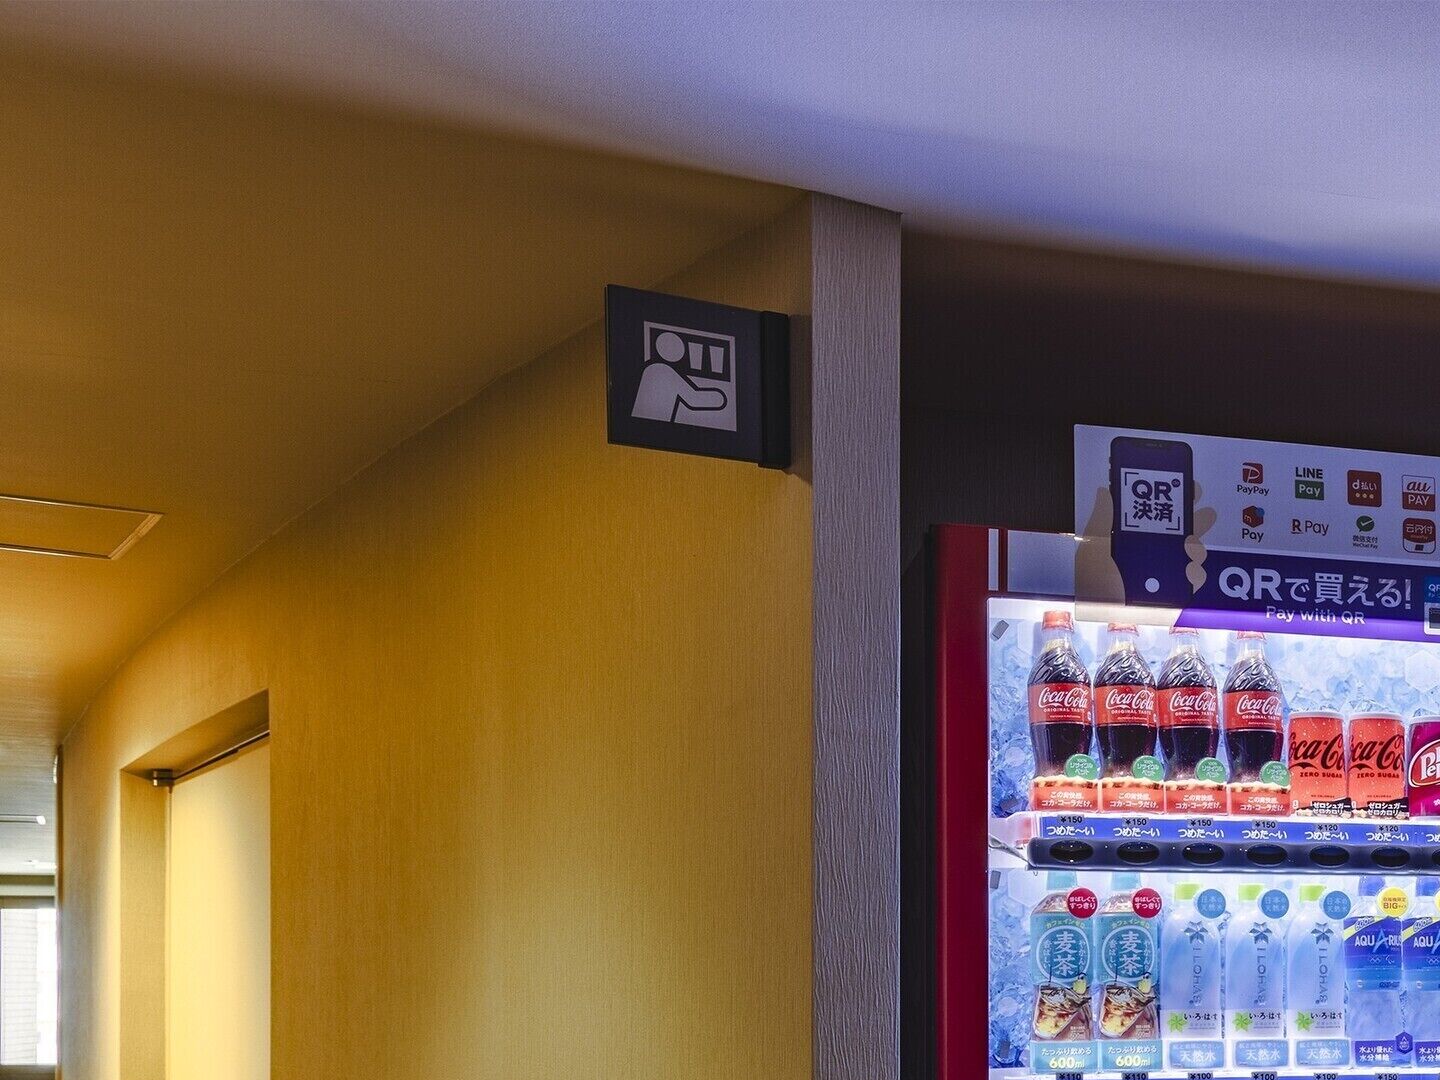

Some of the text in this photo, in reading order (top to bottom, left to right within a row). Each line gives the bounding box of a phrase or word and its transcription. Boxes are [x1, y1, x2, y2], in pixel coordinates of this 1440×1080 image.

[1296, 467, 1323, 479] LINE
[1132, 479, 1173, 501] QR
[1237, 484, 1269, 496] PayPay
[1299, 484, 1321, 497] Pay
[1407, 481, 1431, 492] au
[1408, 495, 1429, 506] PAY
[1133, 500, 1174, 523] 決済
[1242, 529, 1264, 543] Pay
[1305, 520, 1329, 535] Pay
[1218, 566, 1412, 609] QRで買える!
[1266, 605, 1365, 624] Pay with QR
[1039, 687, 1089, 709] Coca-Cola
[1106, 689, 1154, 710] Coca-Cola
[1170, 691, 1216, 711] Coca-Cola
[1237, 694, 1282, 714] Coca-Cola
[1054, 931, 1077, 976] 麦茶
[1119, 931, 1142, 976] 麦茶
[1180, 1050, 1216, 1063] 天然水
[1246, 1048, 1280, 1060] 天然水
